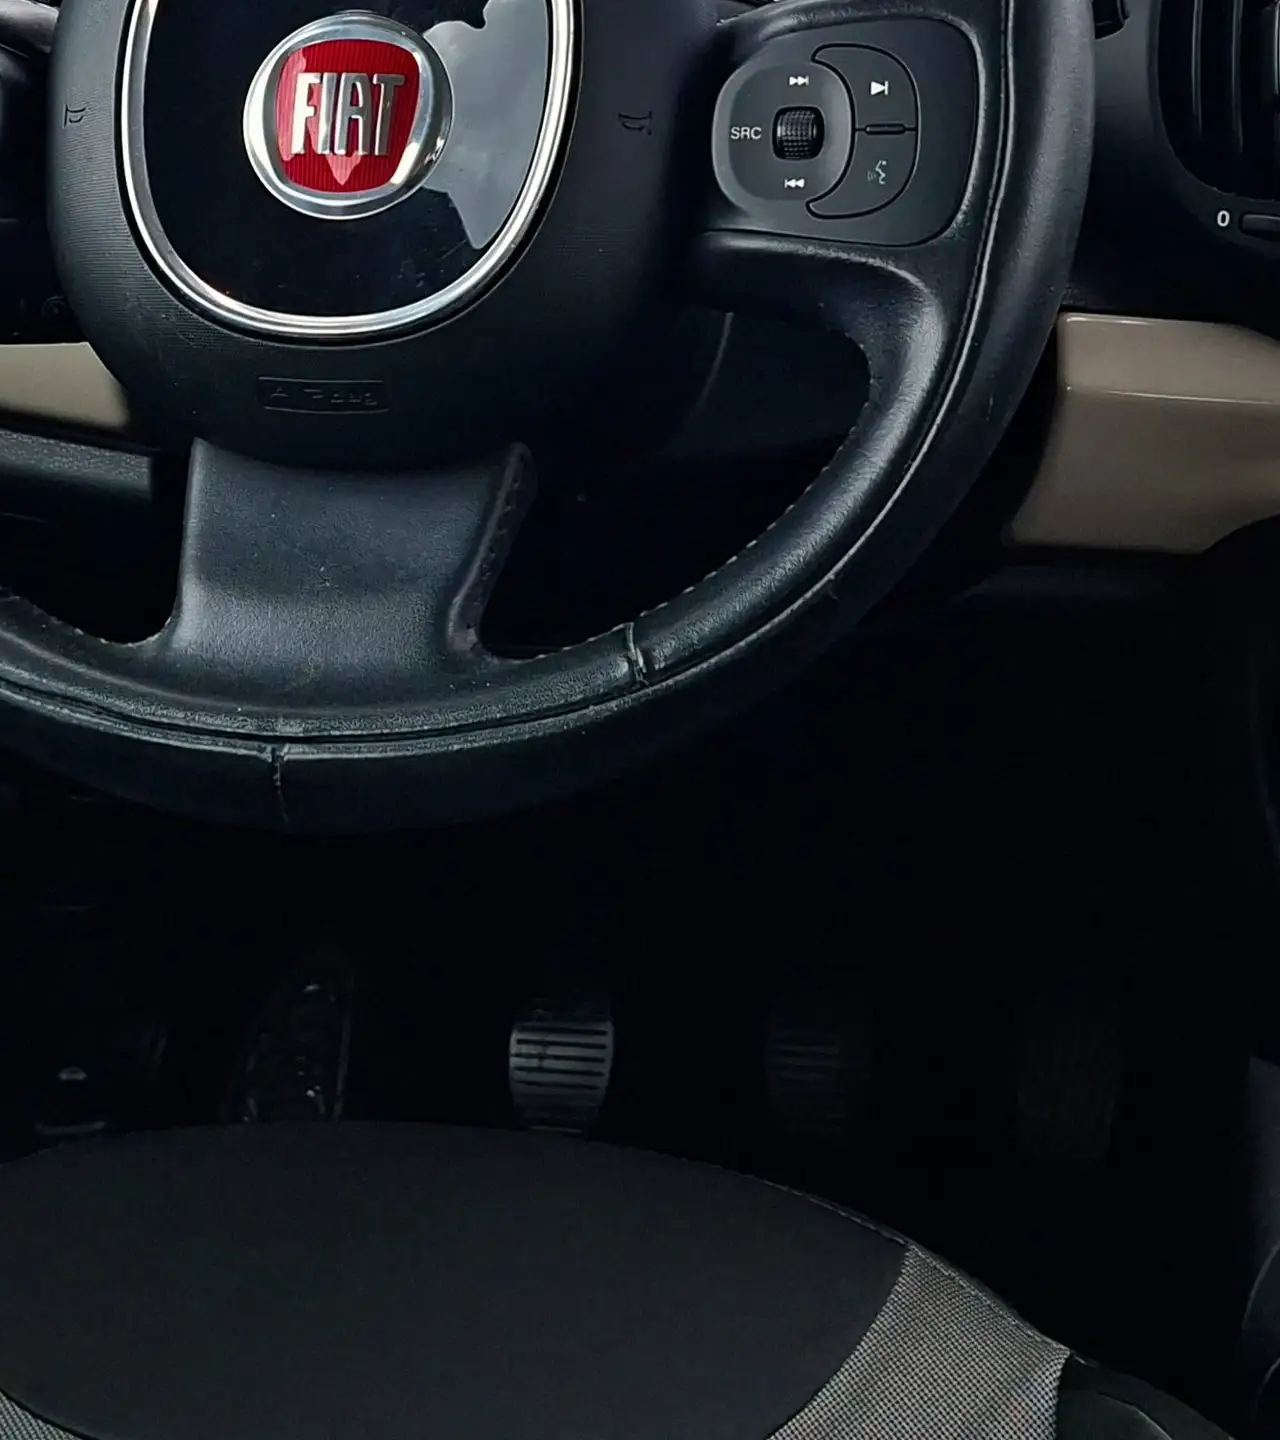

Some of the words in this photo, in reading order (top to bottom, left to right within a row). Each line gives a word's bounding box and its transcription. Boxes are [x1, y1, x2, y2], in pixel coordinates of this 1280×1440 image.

[290, 71, 406, 157] FIAT
[730, 126, 762, 141] SRC
[1216, 210, 1230, 228] 0
